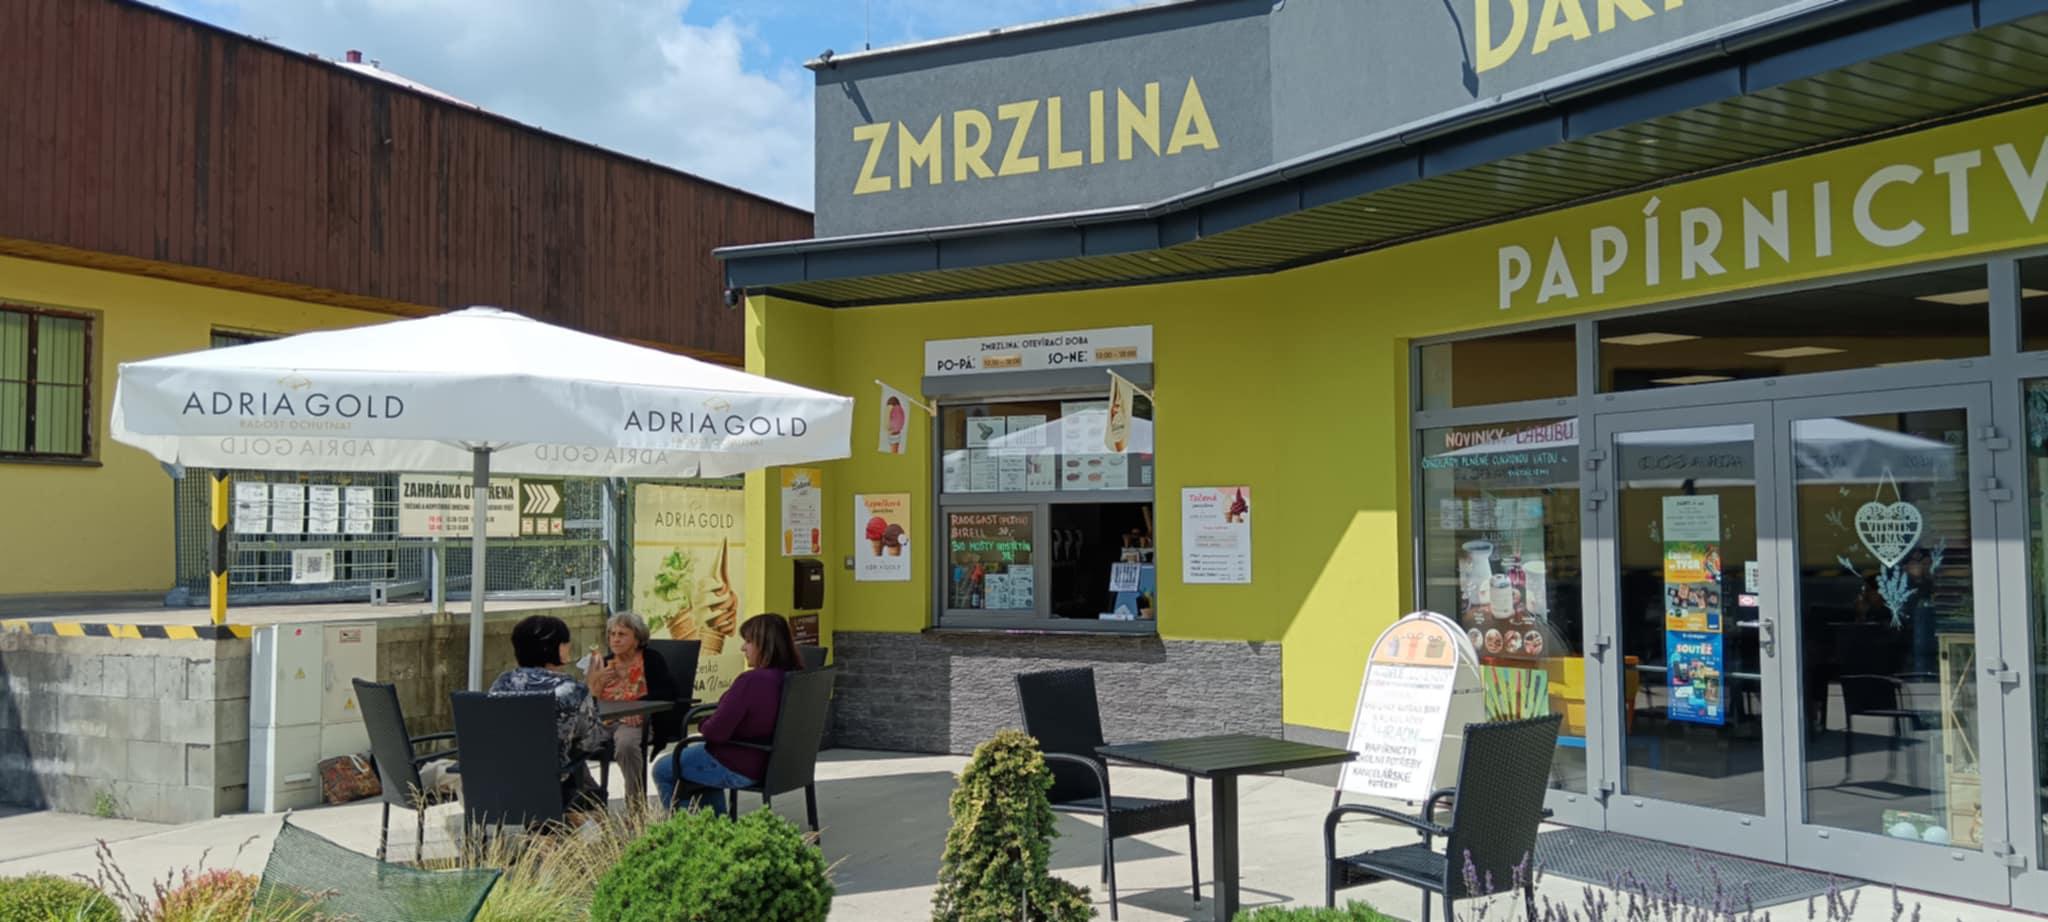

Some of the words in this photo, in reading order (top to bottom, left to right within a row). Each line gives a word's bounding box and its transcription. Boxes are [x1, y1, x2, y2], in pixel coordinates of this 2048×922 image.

[852, 76, 1220, 196] ZMRZLINA
[1022, 336, 1064, 349] OTEVÍRACÍ
[1066, 336, 1089, 346] DOBA
[182, 391, 295, 416] ADRIA
[305, 393, 404, 419] GOLD
[624, 410, 717, 434] ADRIA
[724, 415, 808, 437] GOLD
[1516, 422, 1574, 444] LABUBU
[403, 480, 461, 500] ZAHRÁDKA
[464, 481, 515, 501] OTŘENA
[655, 511, 696, 529] ADRIA
[698, 512, 734, 529] GOLD
[951, 514, 998, 526] RADEGAST
